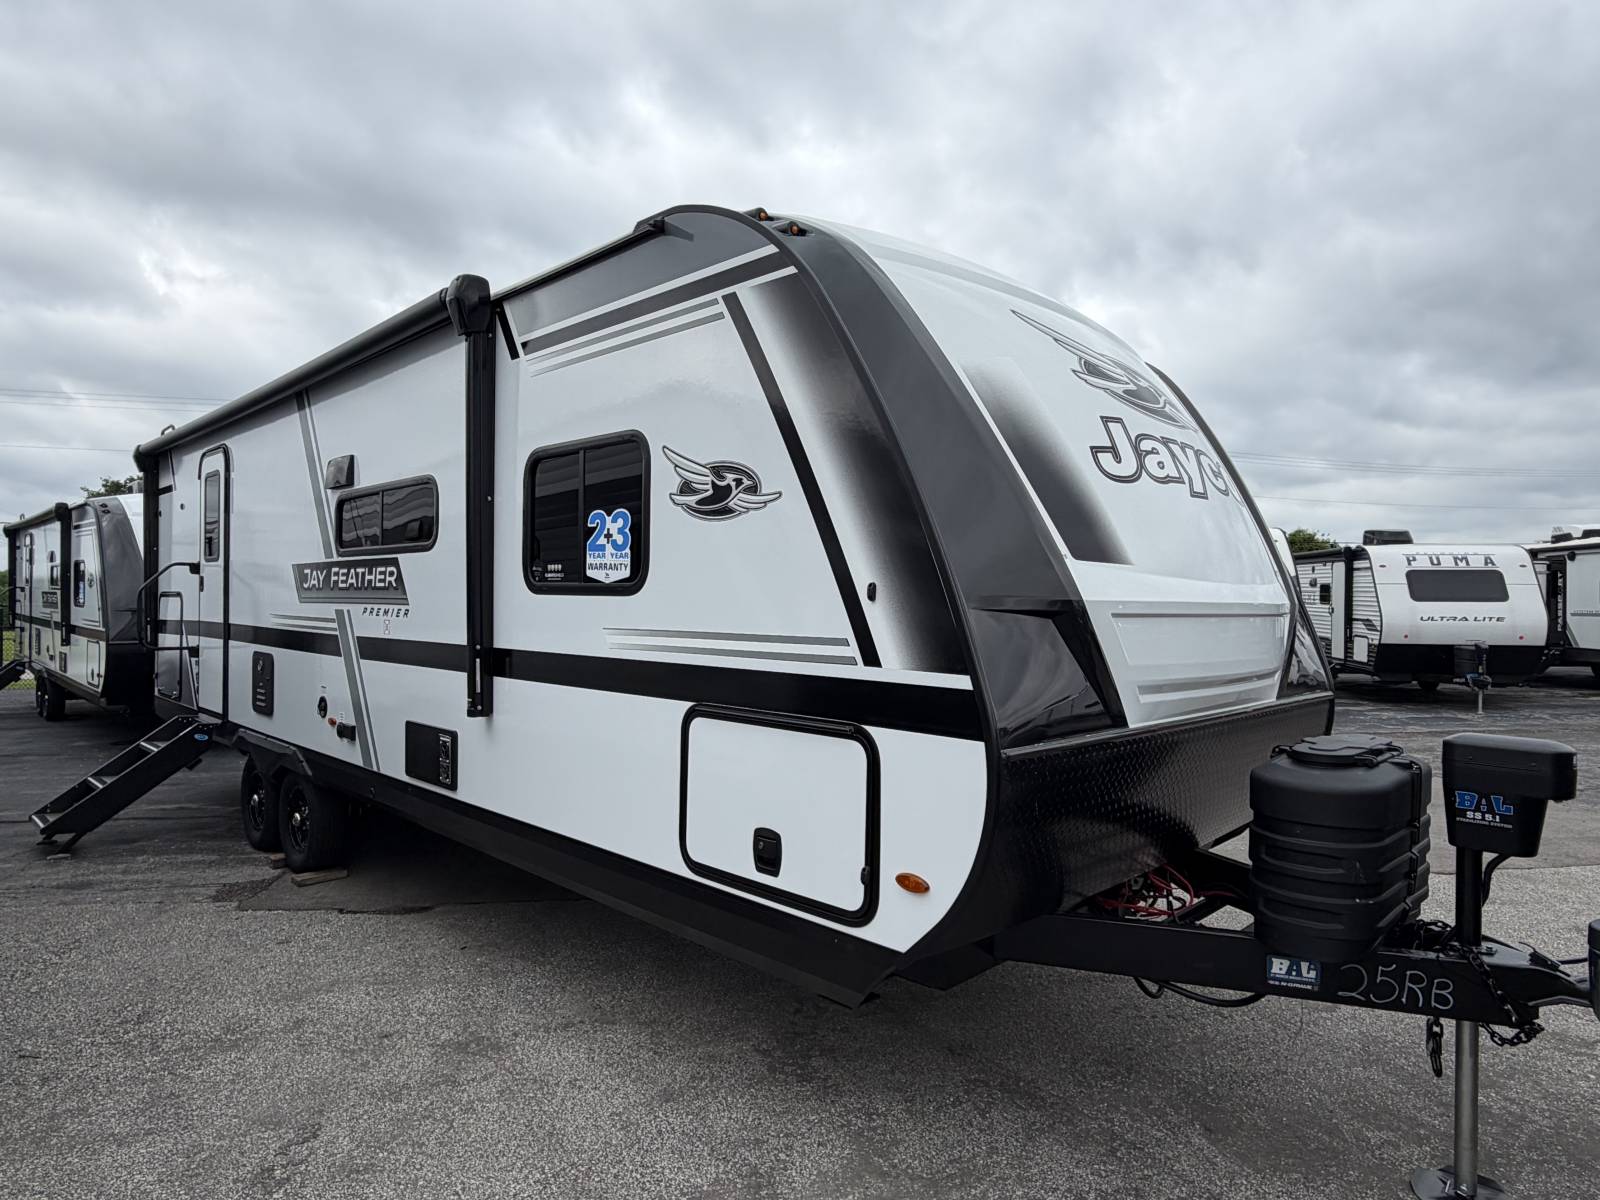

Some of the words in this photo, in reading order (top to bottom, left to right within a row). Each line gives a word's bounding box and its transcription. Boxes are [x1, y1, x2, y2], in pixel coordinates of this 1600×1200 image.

[1089, 415, 1235, 503] Jayc
[588, 552, 606, 560] YEAR
[610, 552, 629, 560] YEAR
[1405, 555, 1497, 567] PUMA
[587, 562, 629, 572] WARRANTY
[302, 568, 327, 589] JAY
[330, 566, 398, 589] FEATHER
[361, 607, 410, 618] PREMIER
[1466, 811, 1482, 820] SS
[1484, 813, 1500, 822] 5.1
[1337, 964, 1454, 1010] 25RB
